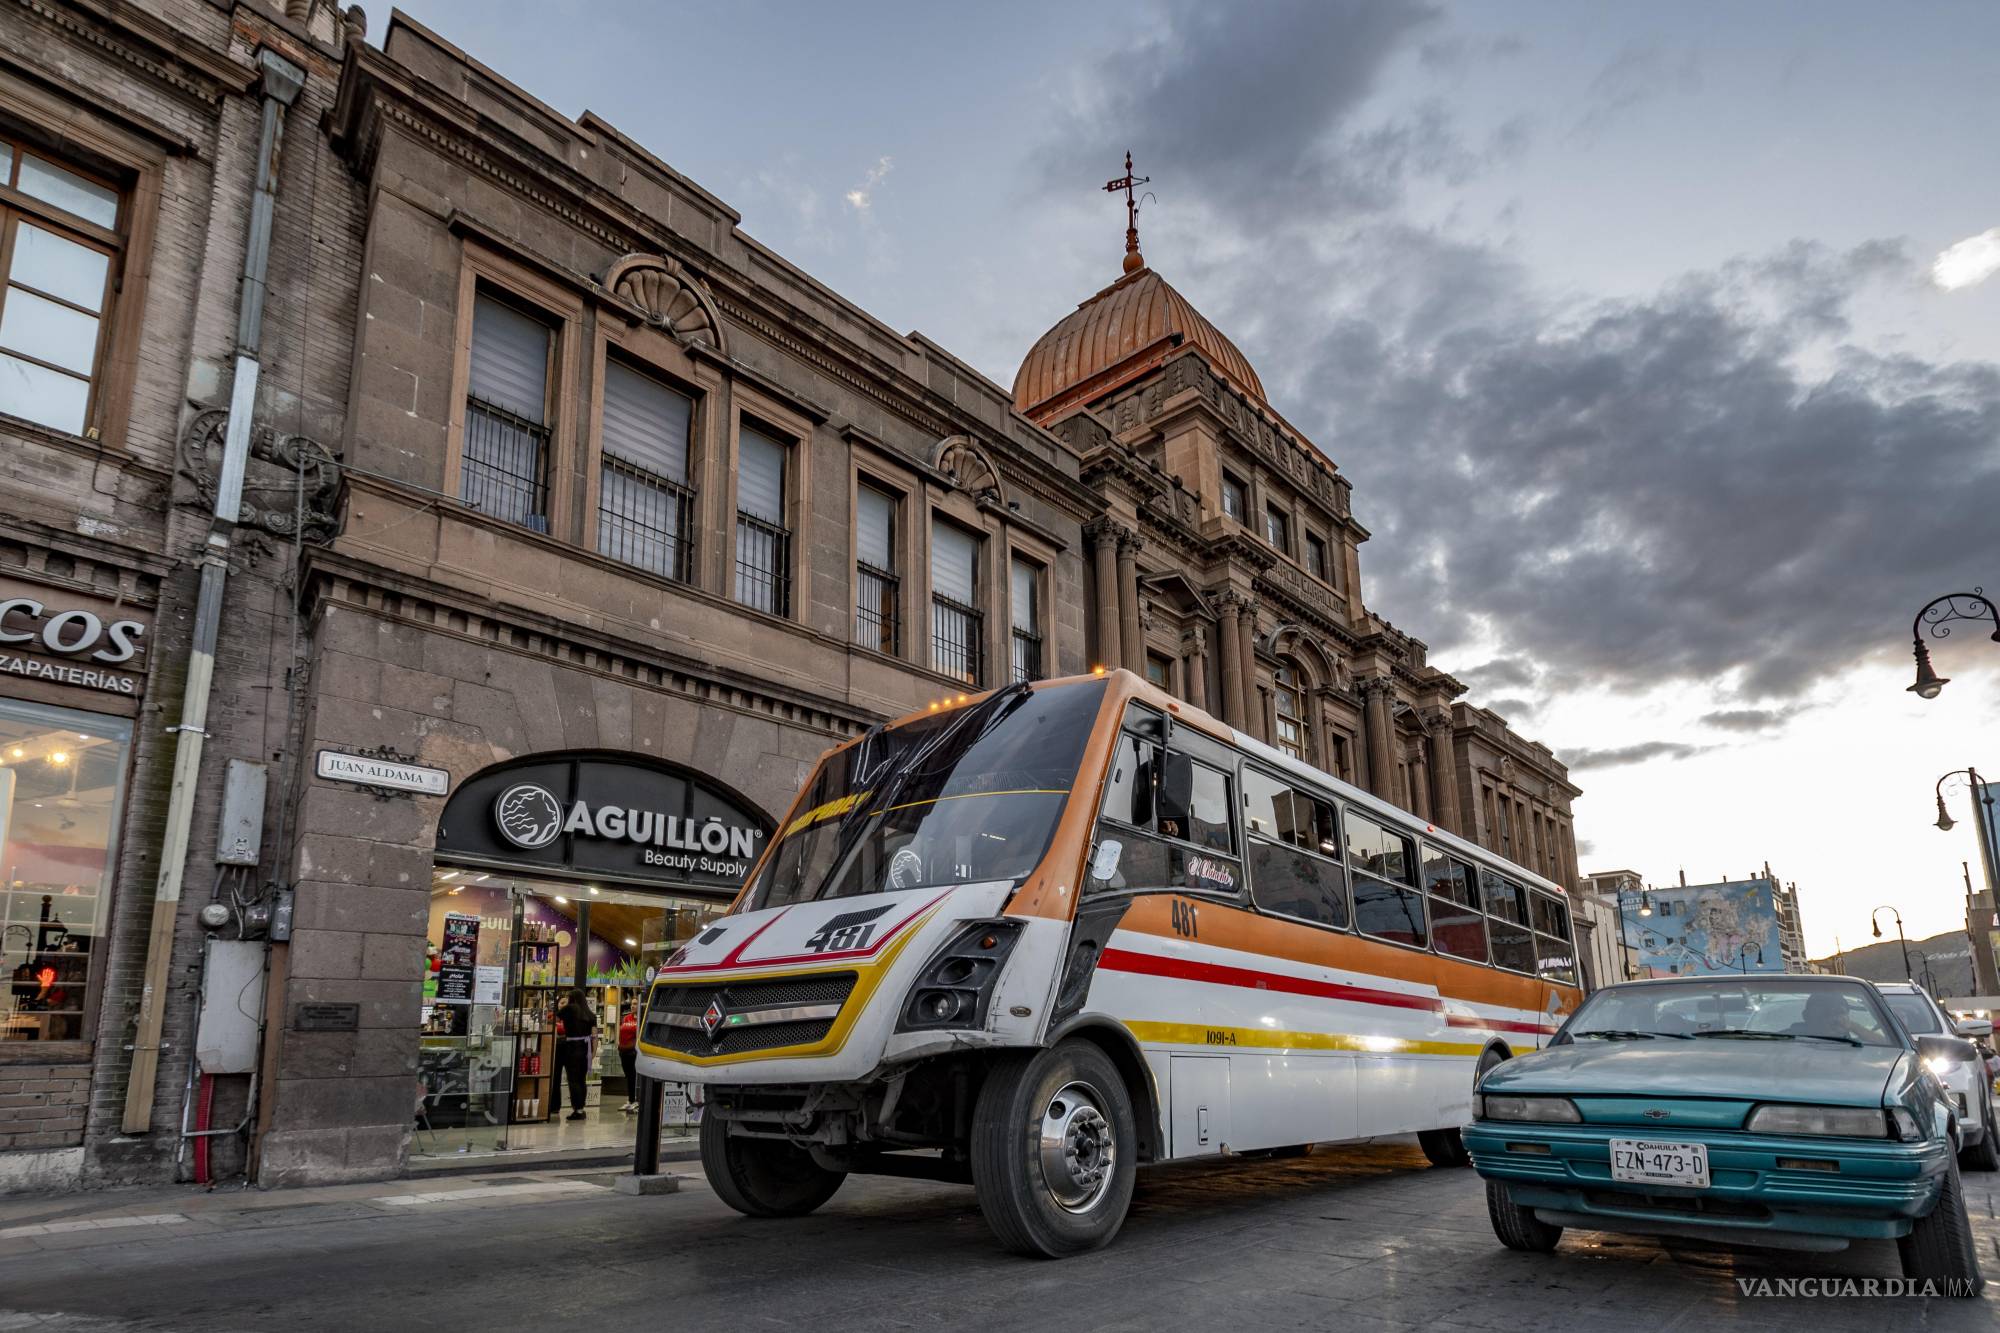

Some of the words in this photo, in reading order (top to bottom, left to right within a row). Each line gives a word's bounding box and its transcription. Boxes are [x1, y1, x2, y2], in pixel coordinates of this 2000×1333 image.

[328, 759, 364, 775] JUAN
[367, 766, 423, 784] ALDAMA
[645, 849, 697, 872] Beauty
[699, 857, 747, 877] Supply
[1172, 899, 1198, 937] 481
[805, 923, 877, 953] 481
[1636, 1142, 1678, 1152] COAHUILA
[1615, 1150, 1703, 1175] EZN-473-D
